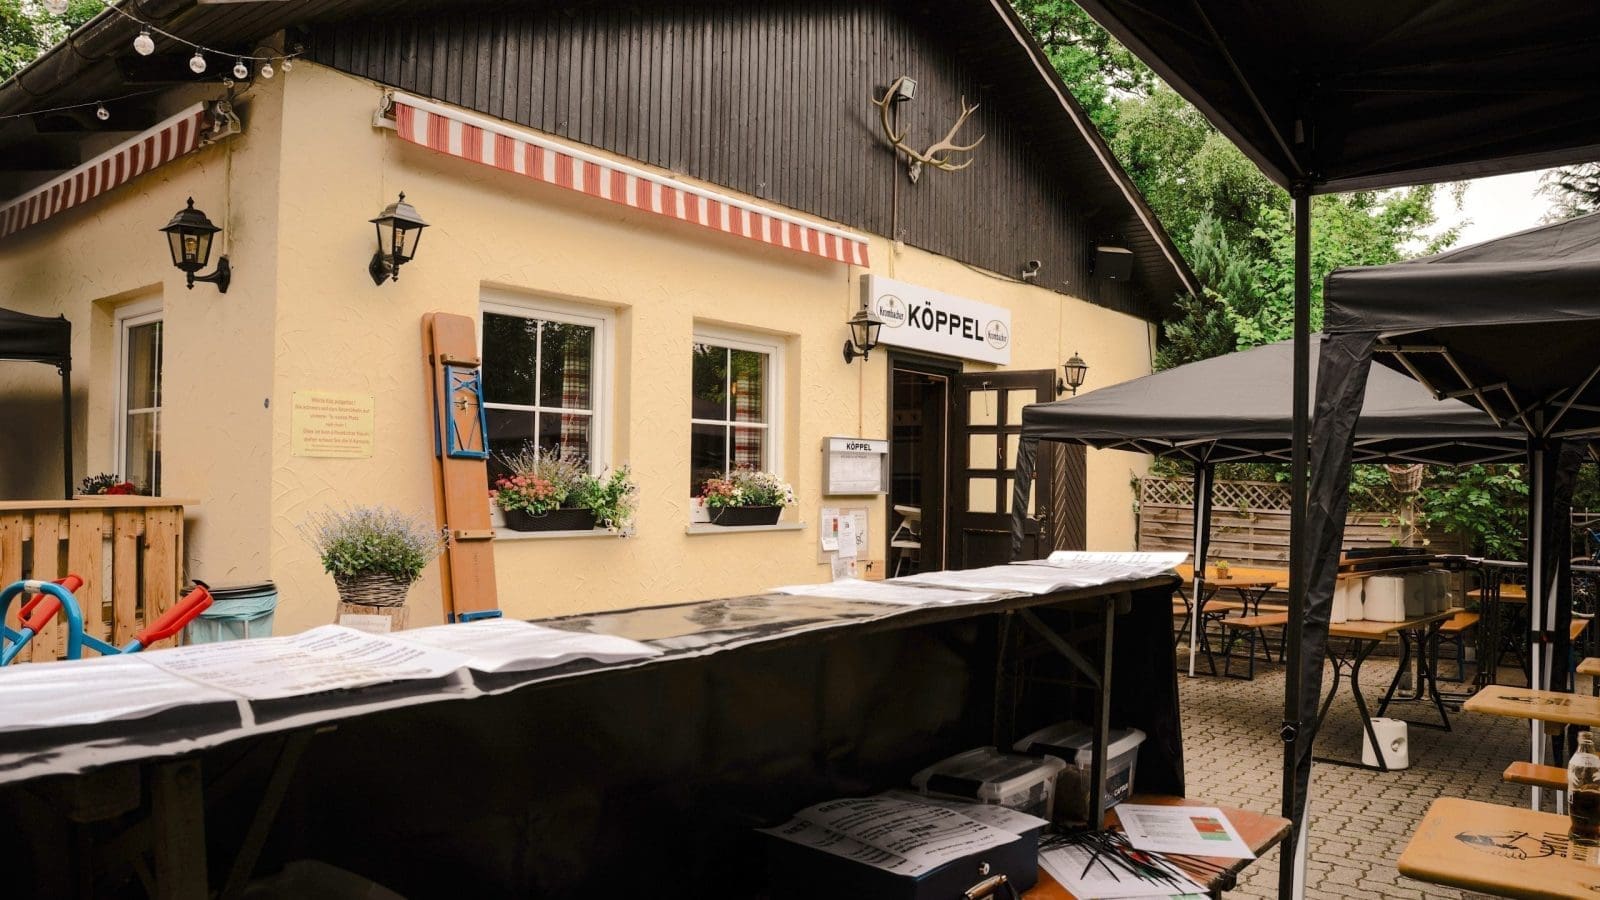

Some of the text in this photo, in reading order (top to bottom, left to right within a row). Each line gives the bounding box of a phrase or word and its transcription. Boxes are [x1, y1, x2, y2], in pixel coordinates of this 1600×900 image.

[879, 305, 904, 320] Krombacher
[908, 301, 984, 342] KÖPPEL
[987, 330, 1007, 343] Krombacher
[846, 440, 872, 451] KÖPPEL
